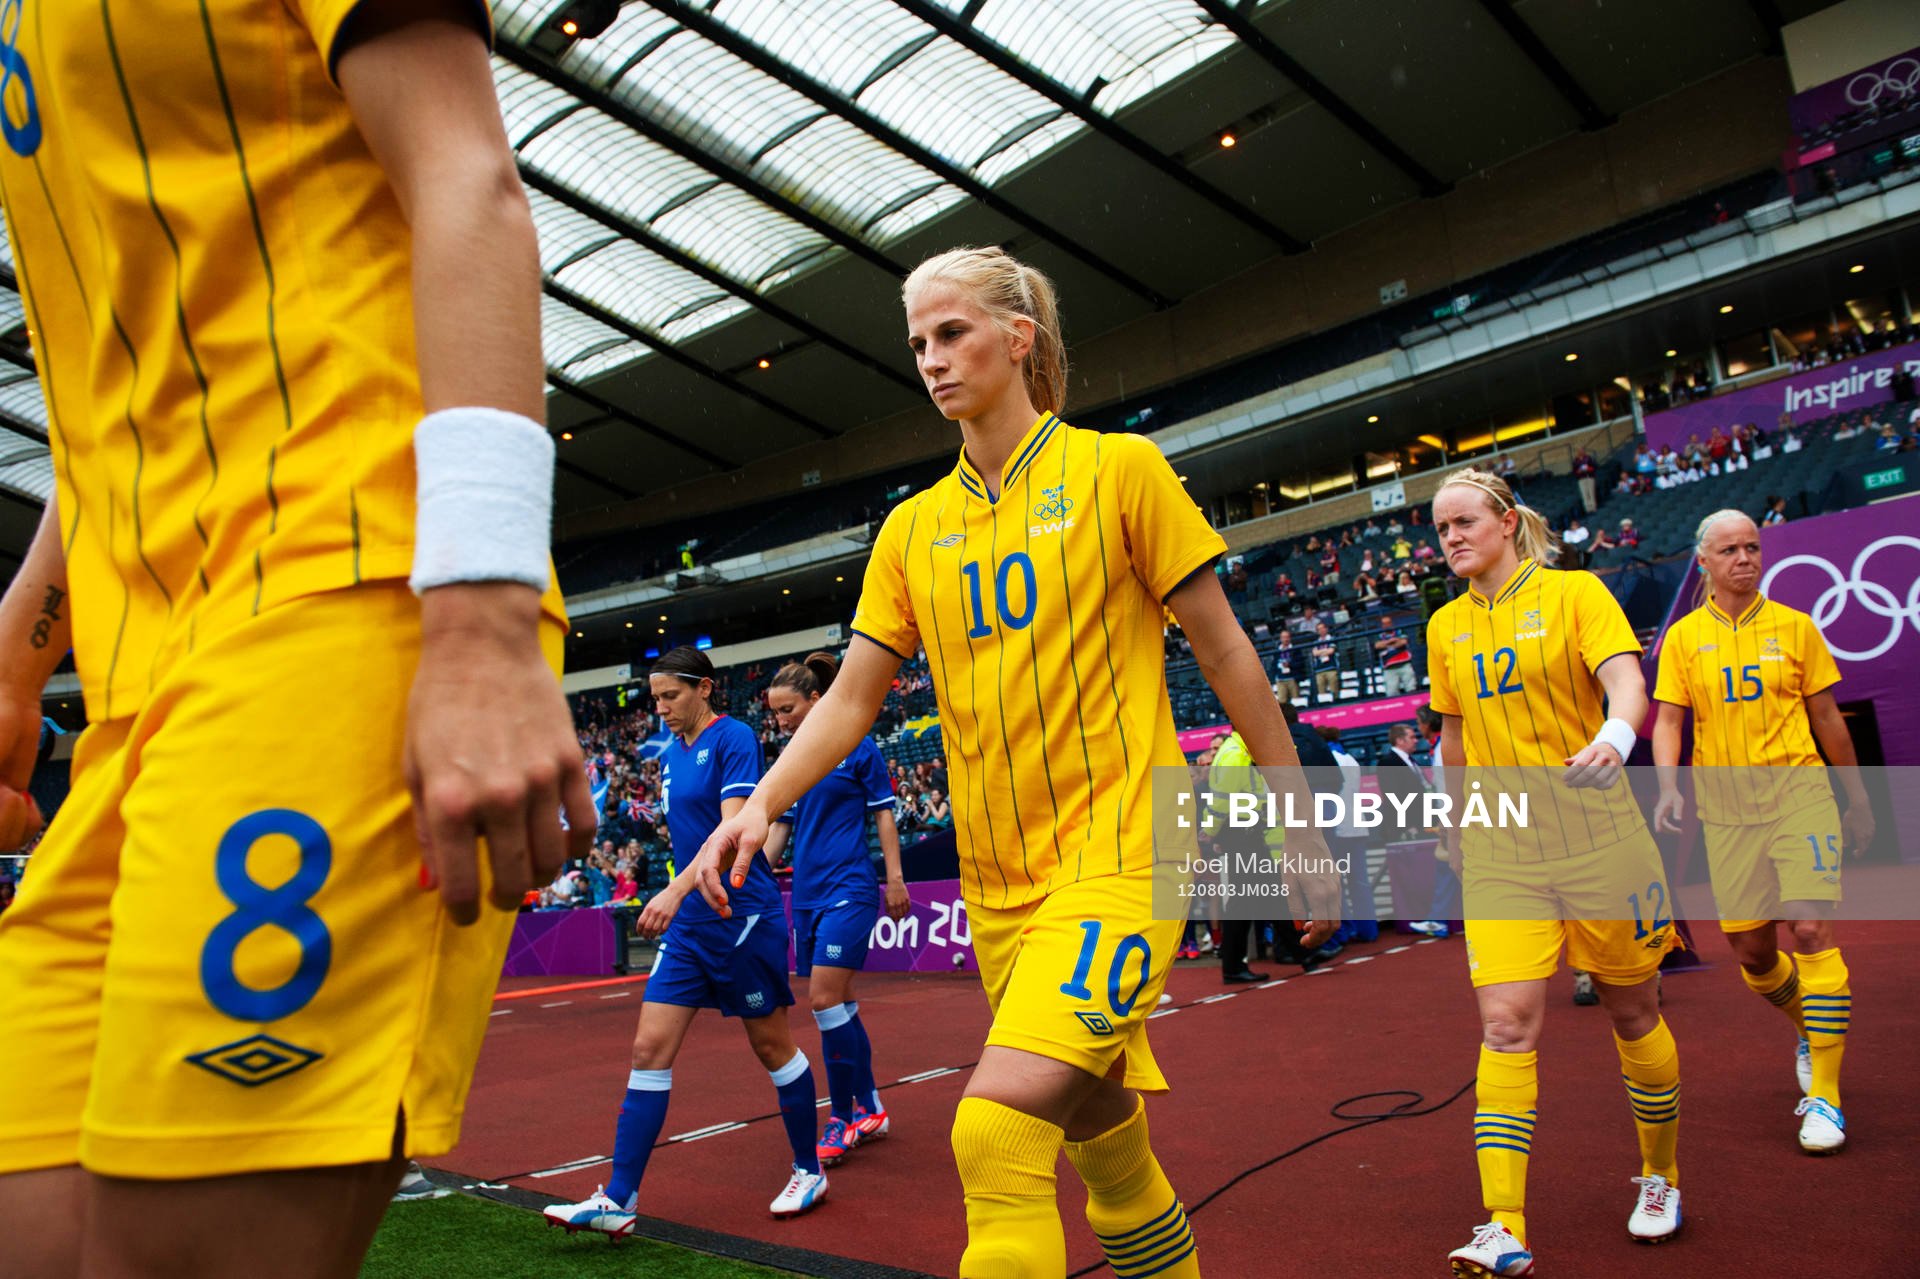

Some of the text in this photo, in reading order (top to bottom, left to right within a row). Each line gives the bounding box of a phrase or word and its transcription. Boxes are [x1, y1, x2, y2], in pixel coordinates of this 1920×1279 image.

[1786, 367, 1894, 412] Inspire
[1868, 471, 1901, 487] EXIT
[1029, 518, 1075, 537] SWE
[962, 552, 1038, 638] 10
[1473, 647, 1523, 698] 12
[1722, 664, 1763, 702] 15
[1806, 834, 1840, 872] 15
[200, 808, 332, 1023] 8
[1627, 881, 1671, 941] 12
[1060, 920, 1151, 1017] 10
